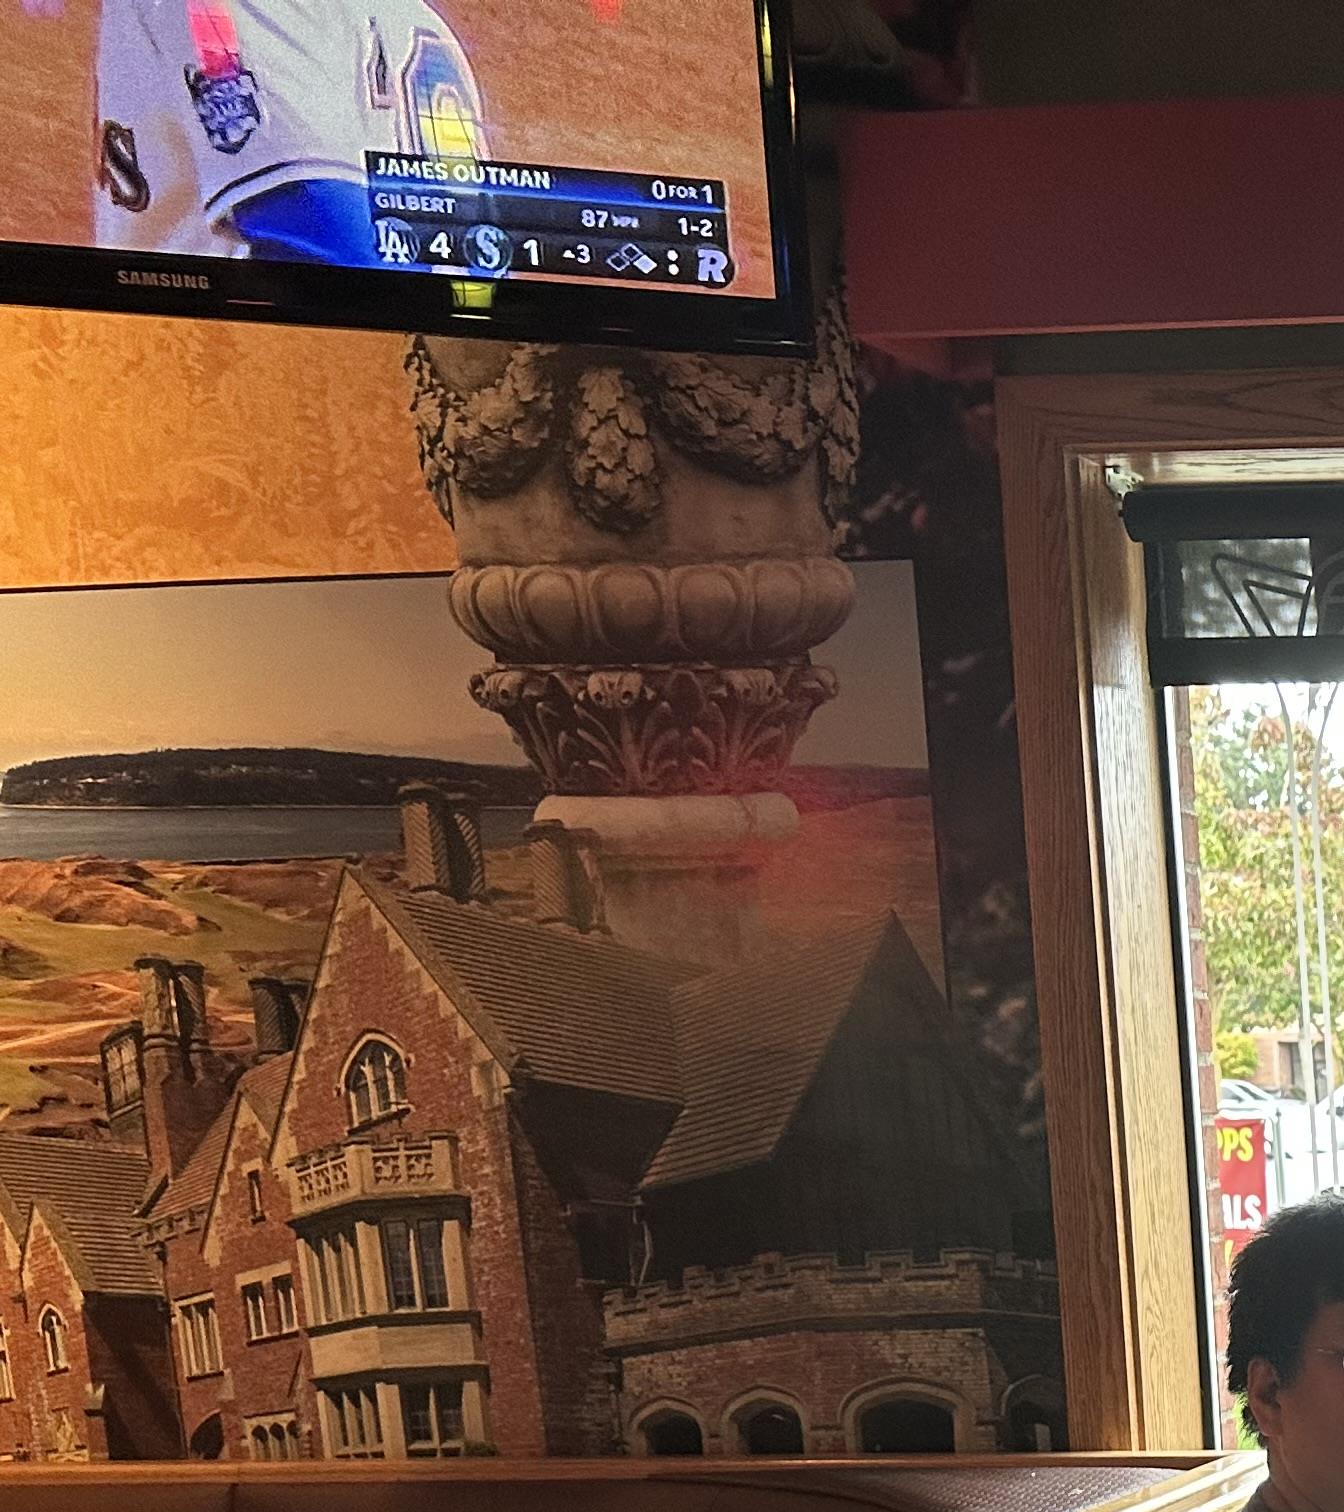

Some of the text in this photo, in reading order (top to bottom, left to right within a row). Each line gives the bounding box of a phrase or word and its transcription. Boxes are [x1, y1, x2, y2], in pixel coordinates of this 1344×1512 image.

[375, 156, 551, 189] JAMES OUTMAN
[374, 192, 456, 214] GILBERT
[651, 180, 713, 204] 0 FOR 1
[581, 209, 608, 228] 87
[677, 217, 714, 238] 1-2
[374, 218, 412, 264] LA
[429, 232, 451, 259] 4
[523, 238, 540, 266] 1
[576, 244, 591, 264] 3
[116, 270, 210, 290] SAMSUNG
